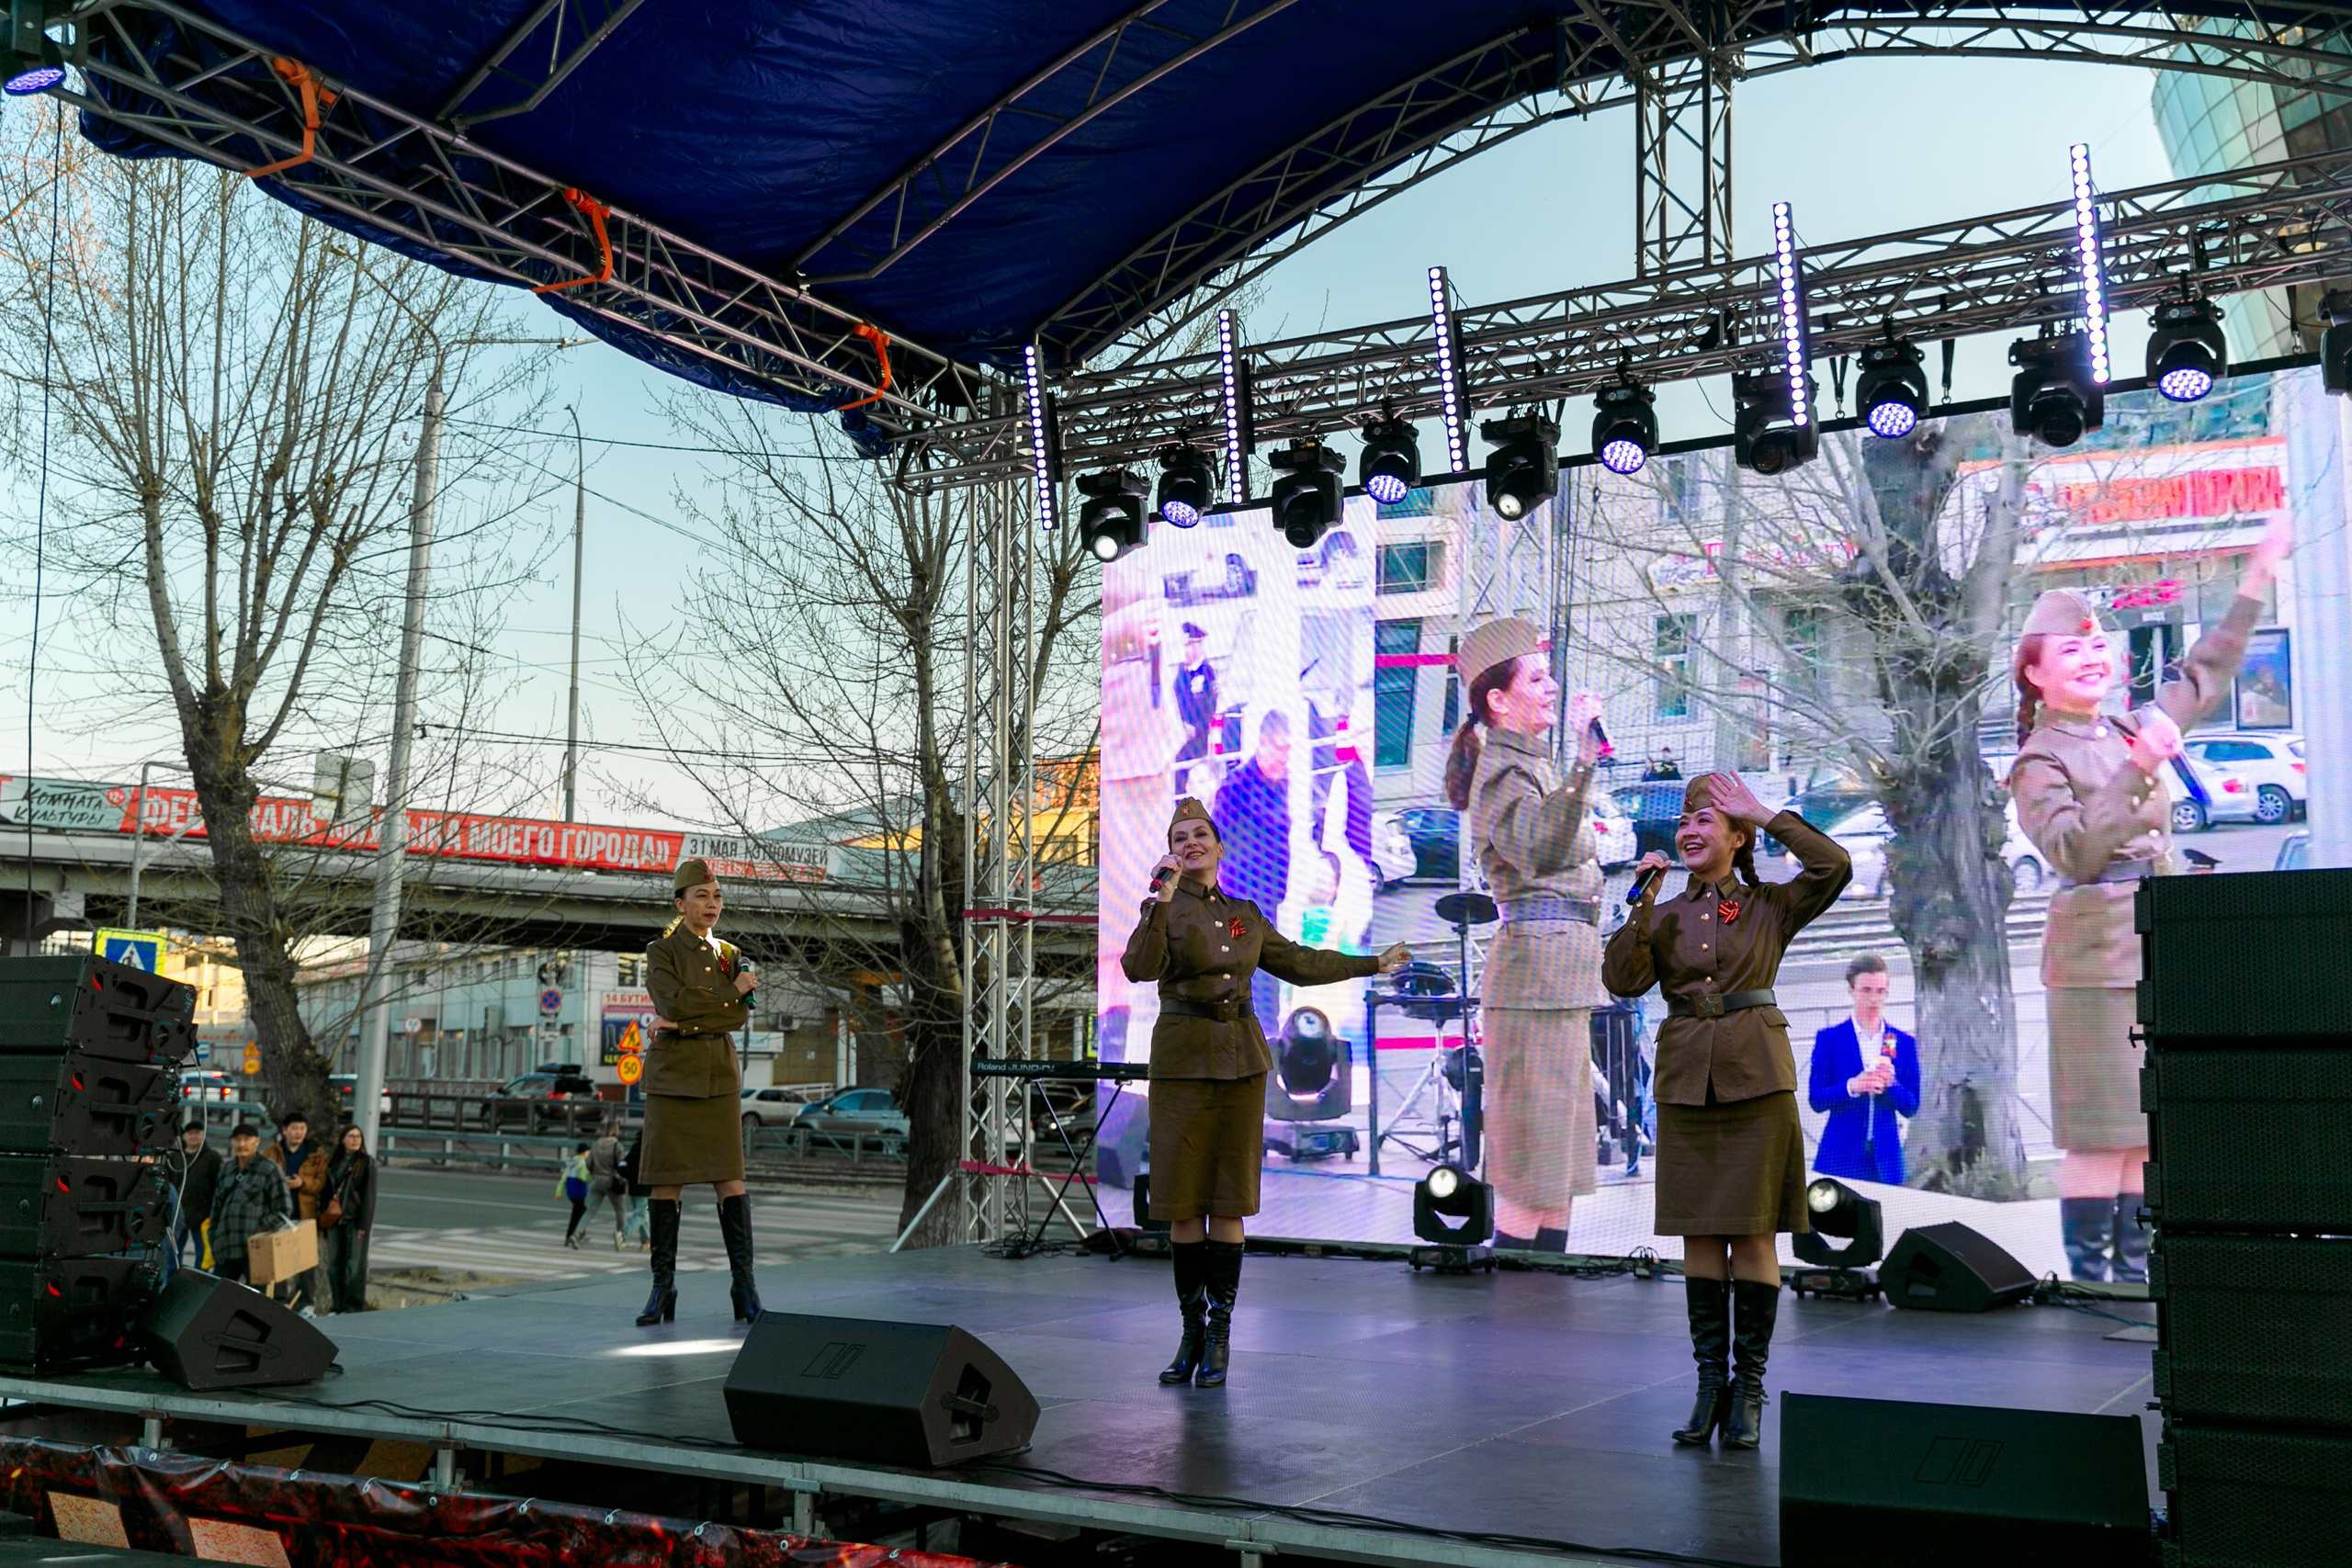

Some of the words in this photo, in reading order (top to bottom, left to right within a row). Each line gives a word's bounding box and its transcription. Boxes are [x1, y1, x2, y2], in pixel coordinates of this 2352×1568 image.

[23, 783, 104, 810] КОМНАТА
[13, 805, 106, 826] КУЛЬТУРЫ
[142, 793, 317, 839] ФЕСВАЛЬ
[469, 820, 555, 858] МОЕГО
[560, 829, 671, 868] ГОРОДА»
[690, 838, 706, 855] 31
[710, 840, 738, 857] МАЯ
[752, 841, 829, 865] ЭТНОМУЗЕЙ
[605, 994, 617, 1002] 14
[623, 1062, 638, 1075] 50
[978, 1063, 1006, 1071] Roland
